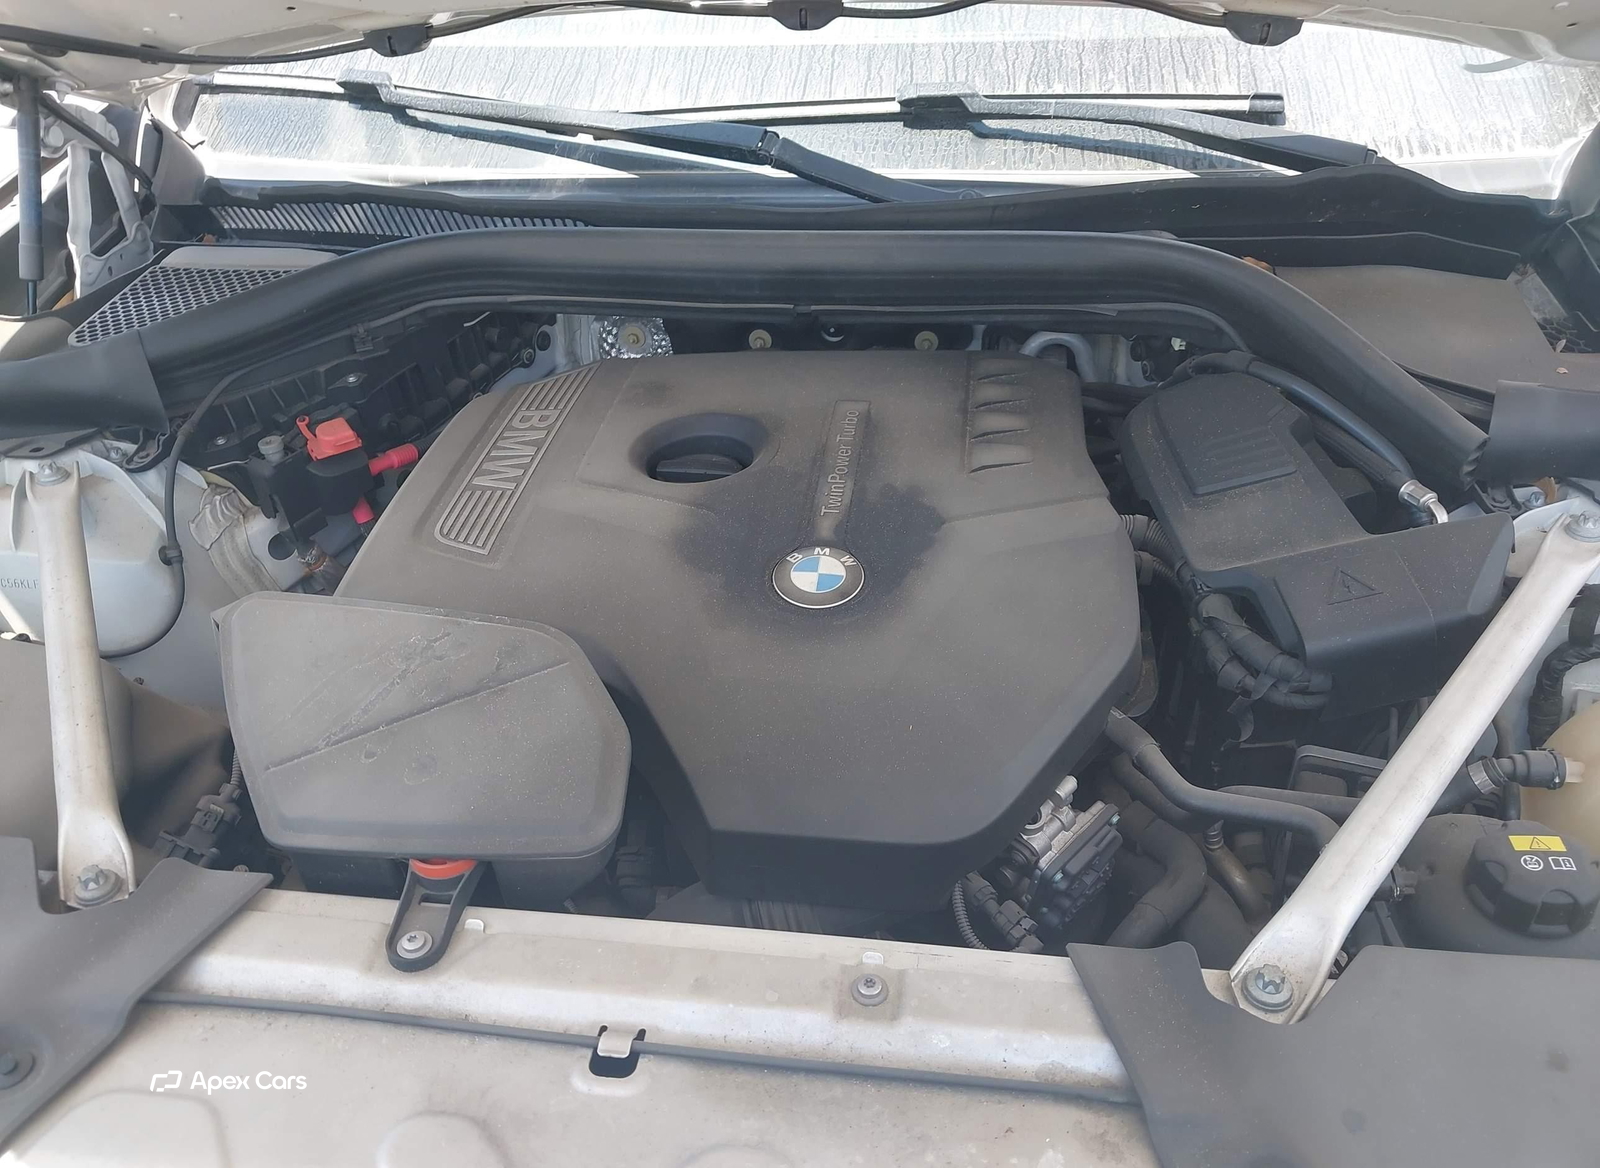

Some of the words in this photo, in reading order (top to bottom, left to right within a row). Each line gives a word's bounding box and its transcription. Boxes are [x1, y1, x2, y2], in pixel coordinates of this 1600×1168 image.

[472, 409, 562, 489] BMW
[820, 444, 852, 516] TwinPower
[836, 410, 859, 442] Turbo
[786, 547, 857, 567] BMW
